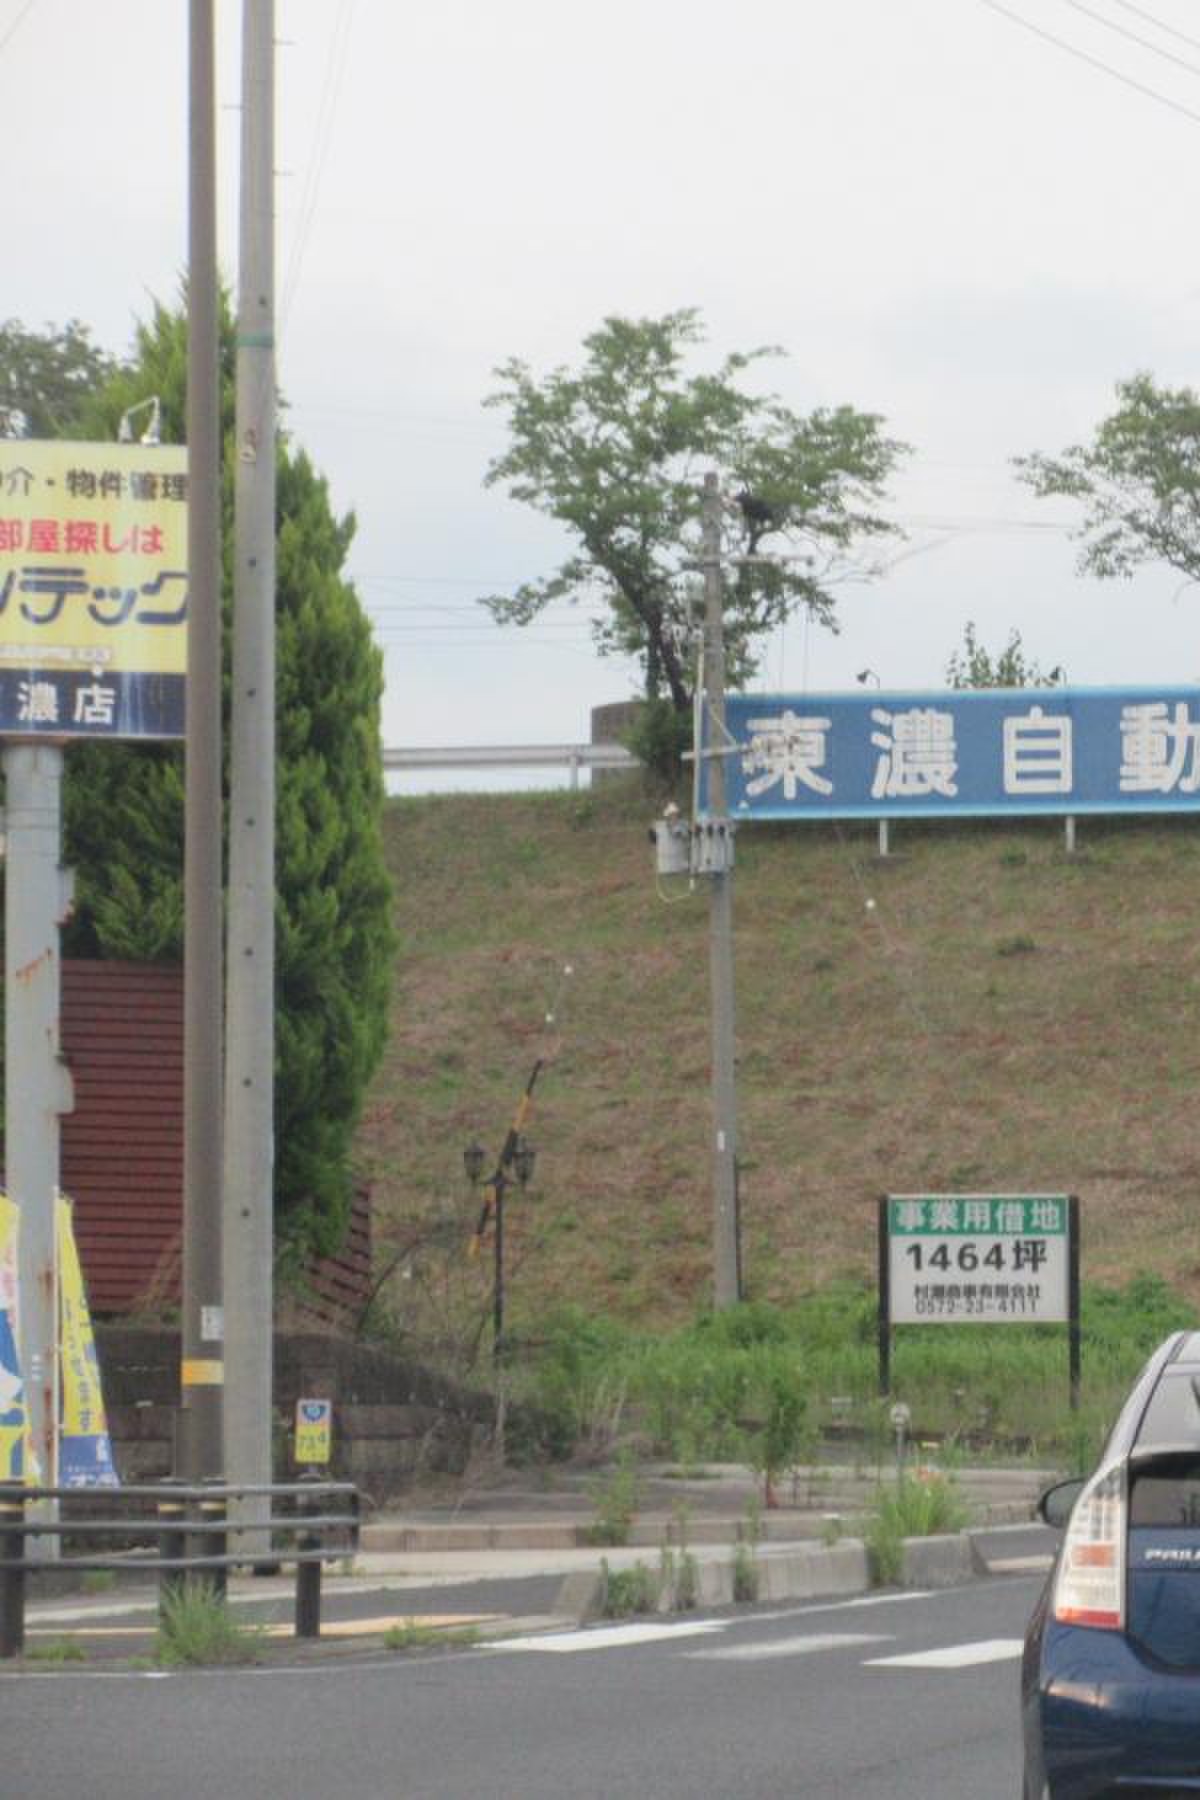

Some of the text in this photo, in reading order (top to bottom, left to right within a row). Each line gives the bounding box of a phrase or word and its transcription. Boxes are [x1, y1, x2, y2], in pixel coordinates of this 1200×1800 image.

[896, 1199, 1060, 1232] 事業用借地
[906, 1239, 1048, 1273] 1464坪
